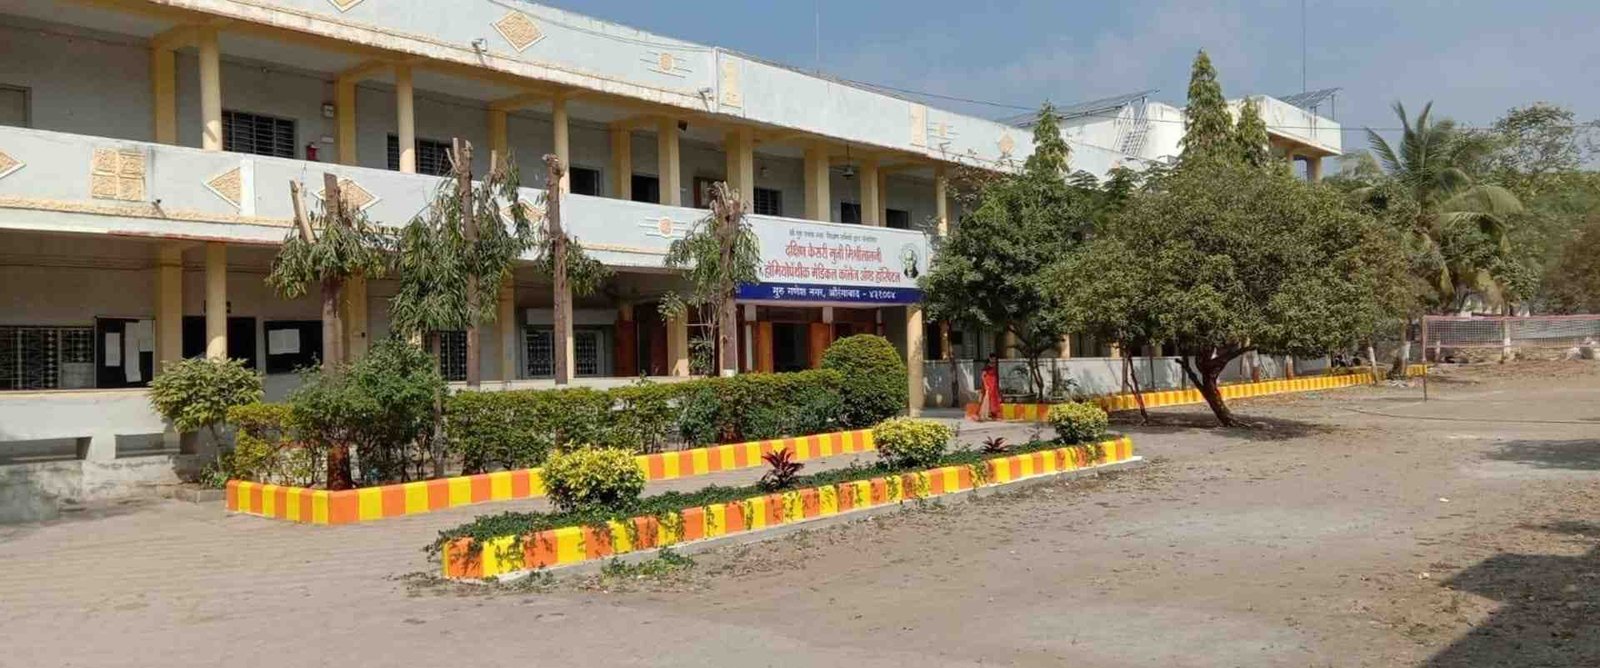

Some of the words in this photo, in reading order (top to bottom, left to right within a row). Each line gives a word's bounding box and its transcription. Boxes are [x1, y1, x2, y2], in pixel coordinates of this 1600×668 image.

[785, 240, 806, 257] दक्षिण
[807, 242, 828, 259] केसरी
[771, 286, 785, 299] गुरु
[787, 285, 807, 297] गणेश
[828, 286, 860, 299] औरंगाबाद
